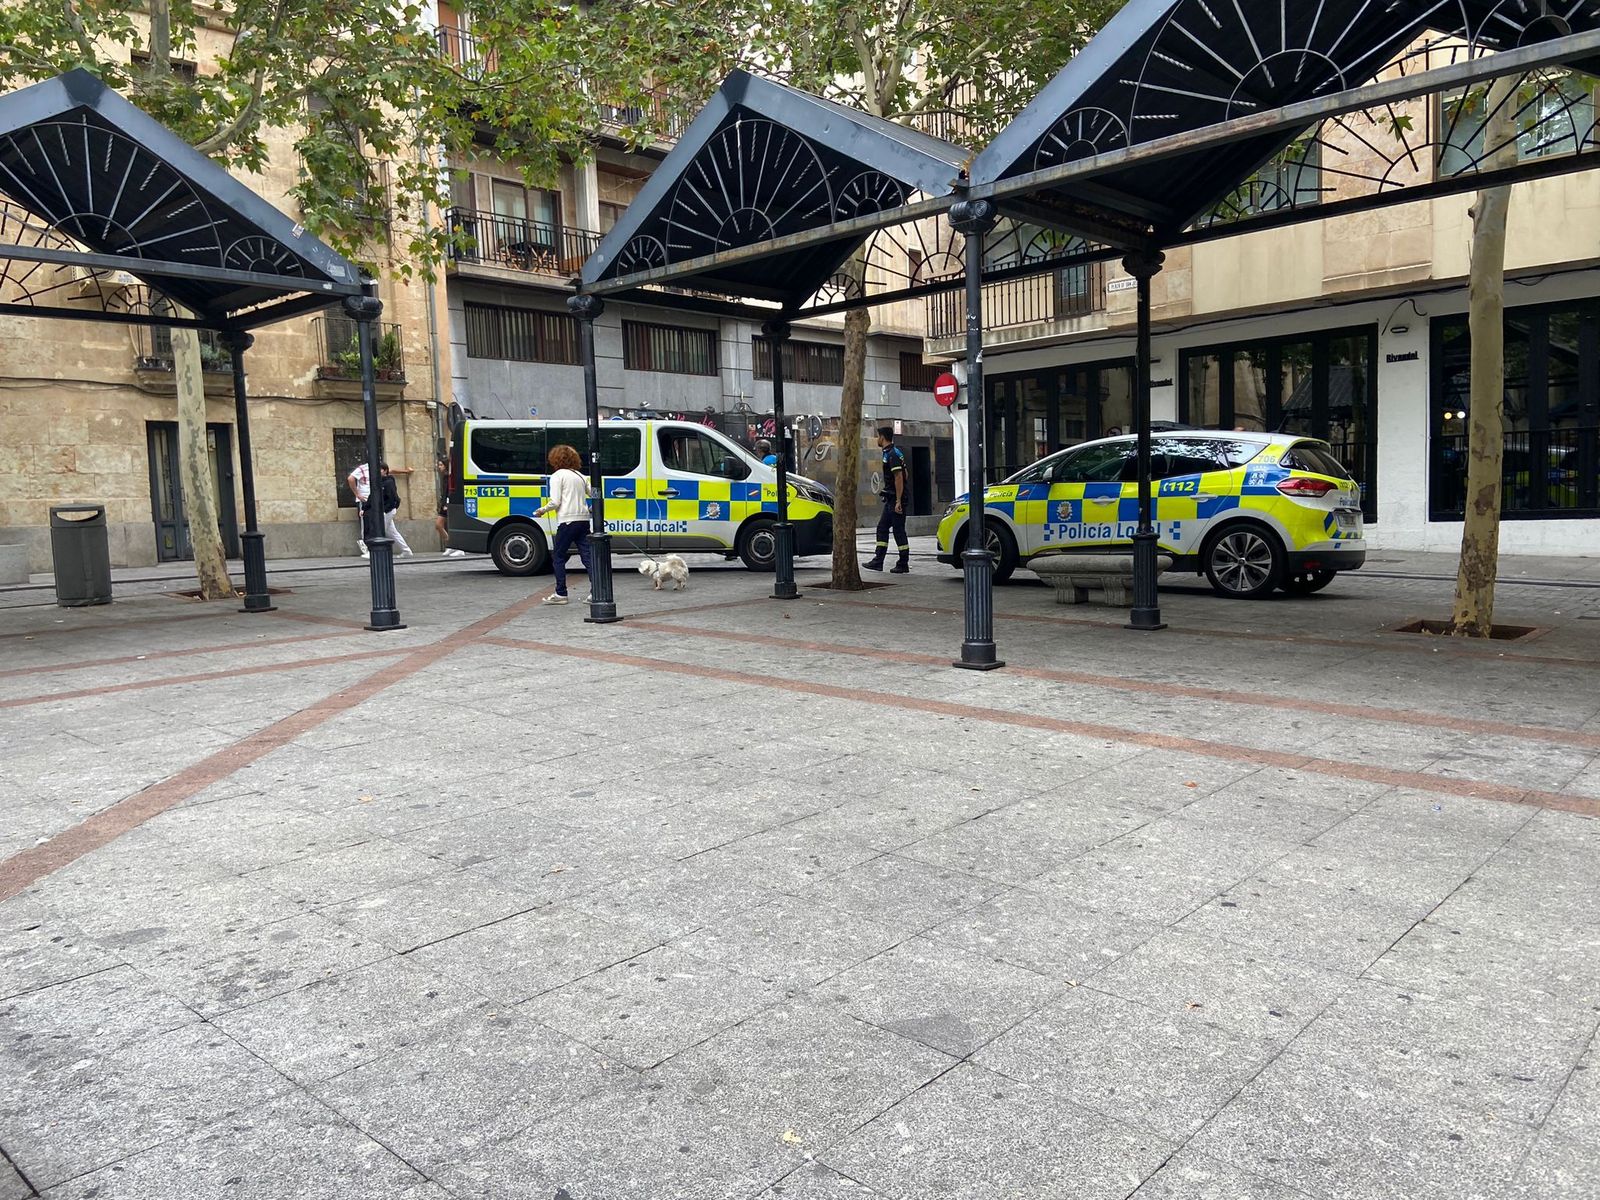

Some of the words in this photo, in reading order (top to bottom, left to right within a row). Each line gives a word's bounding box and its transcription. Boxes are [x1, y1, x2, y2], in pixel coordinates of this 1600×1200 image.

[1258, 455, 1276, 463] 706
[1168, 481, 1195, 492] 112
[465, 488, 477, 496] 713
[485, 487, 506, 497] 112
[647, 520, 680, 533] Local
[1058, 523, 1111, 539] Policía
